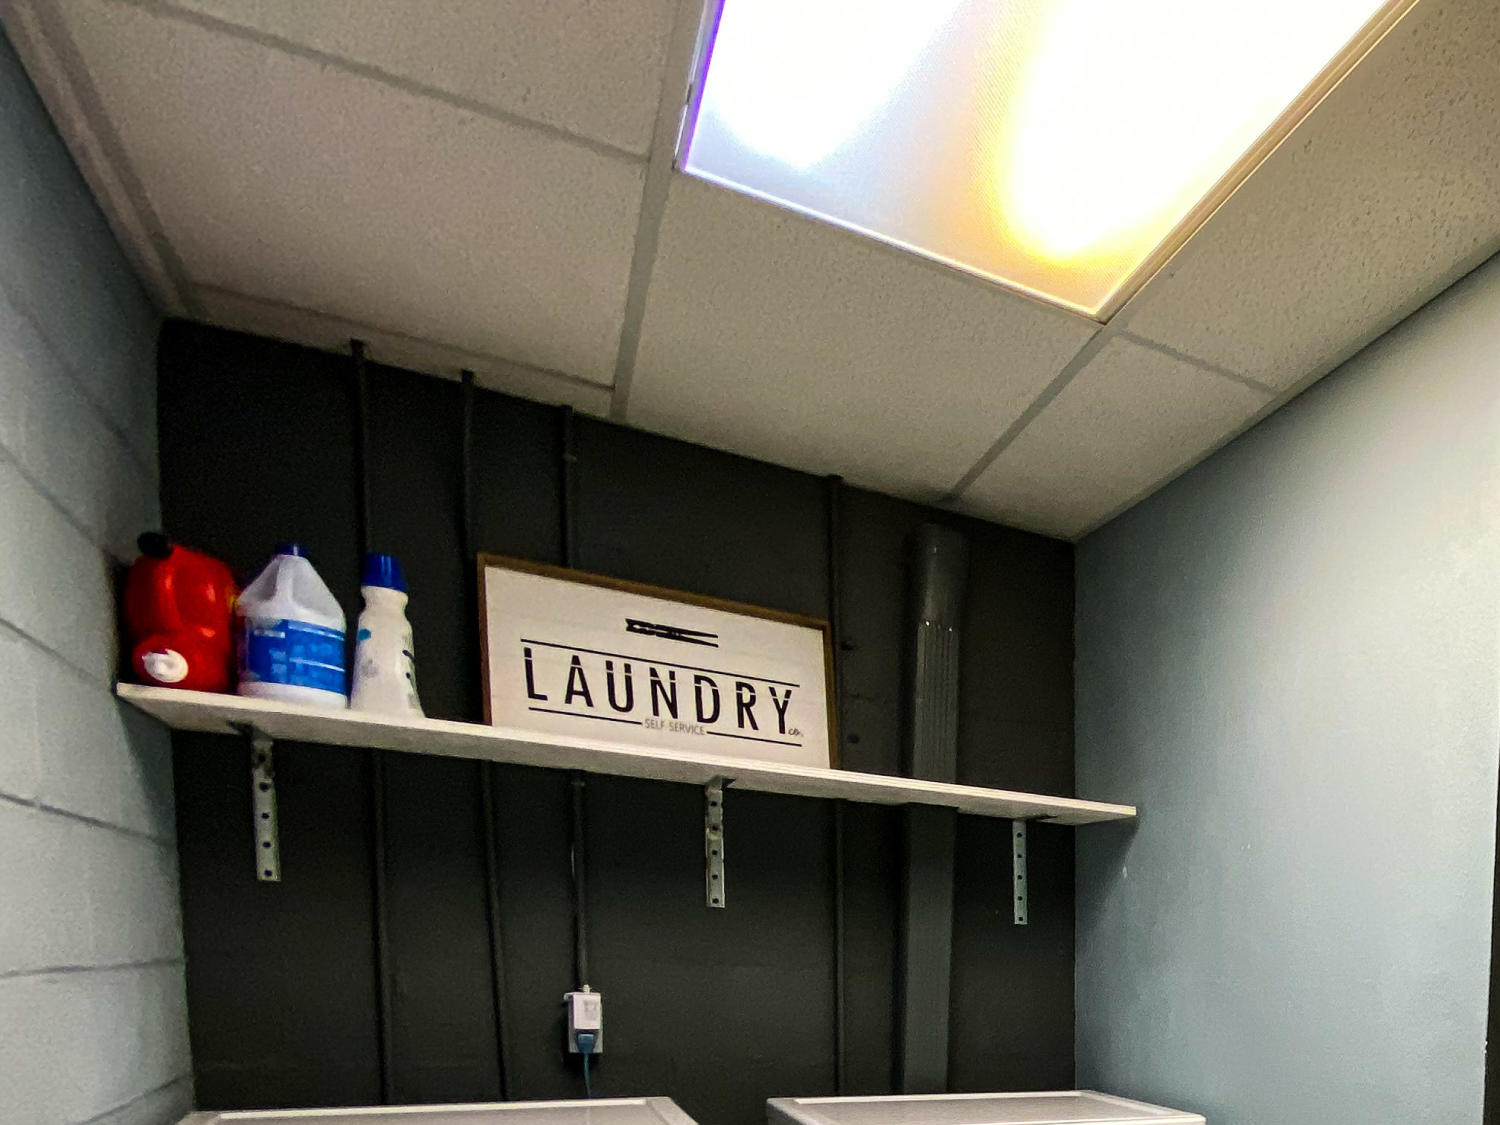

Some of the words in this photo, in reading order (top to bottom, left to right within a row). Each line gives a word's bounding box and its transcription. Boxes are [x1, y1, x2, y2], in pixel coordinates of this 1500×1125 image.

[523, 646, 793, 735] LAUNDRY
[644, 718, 665, 730] SELF
[669, 721, 706, 736] SERVICE
